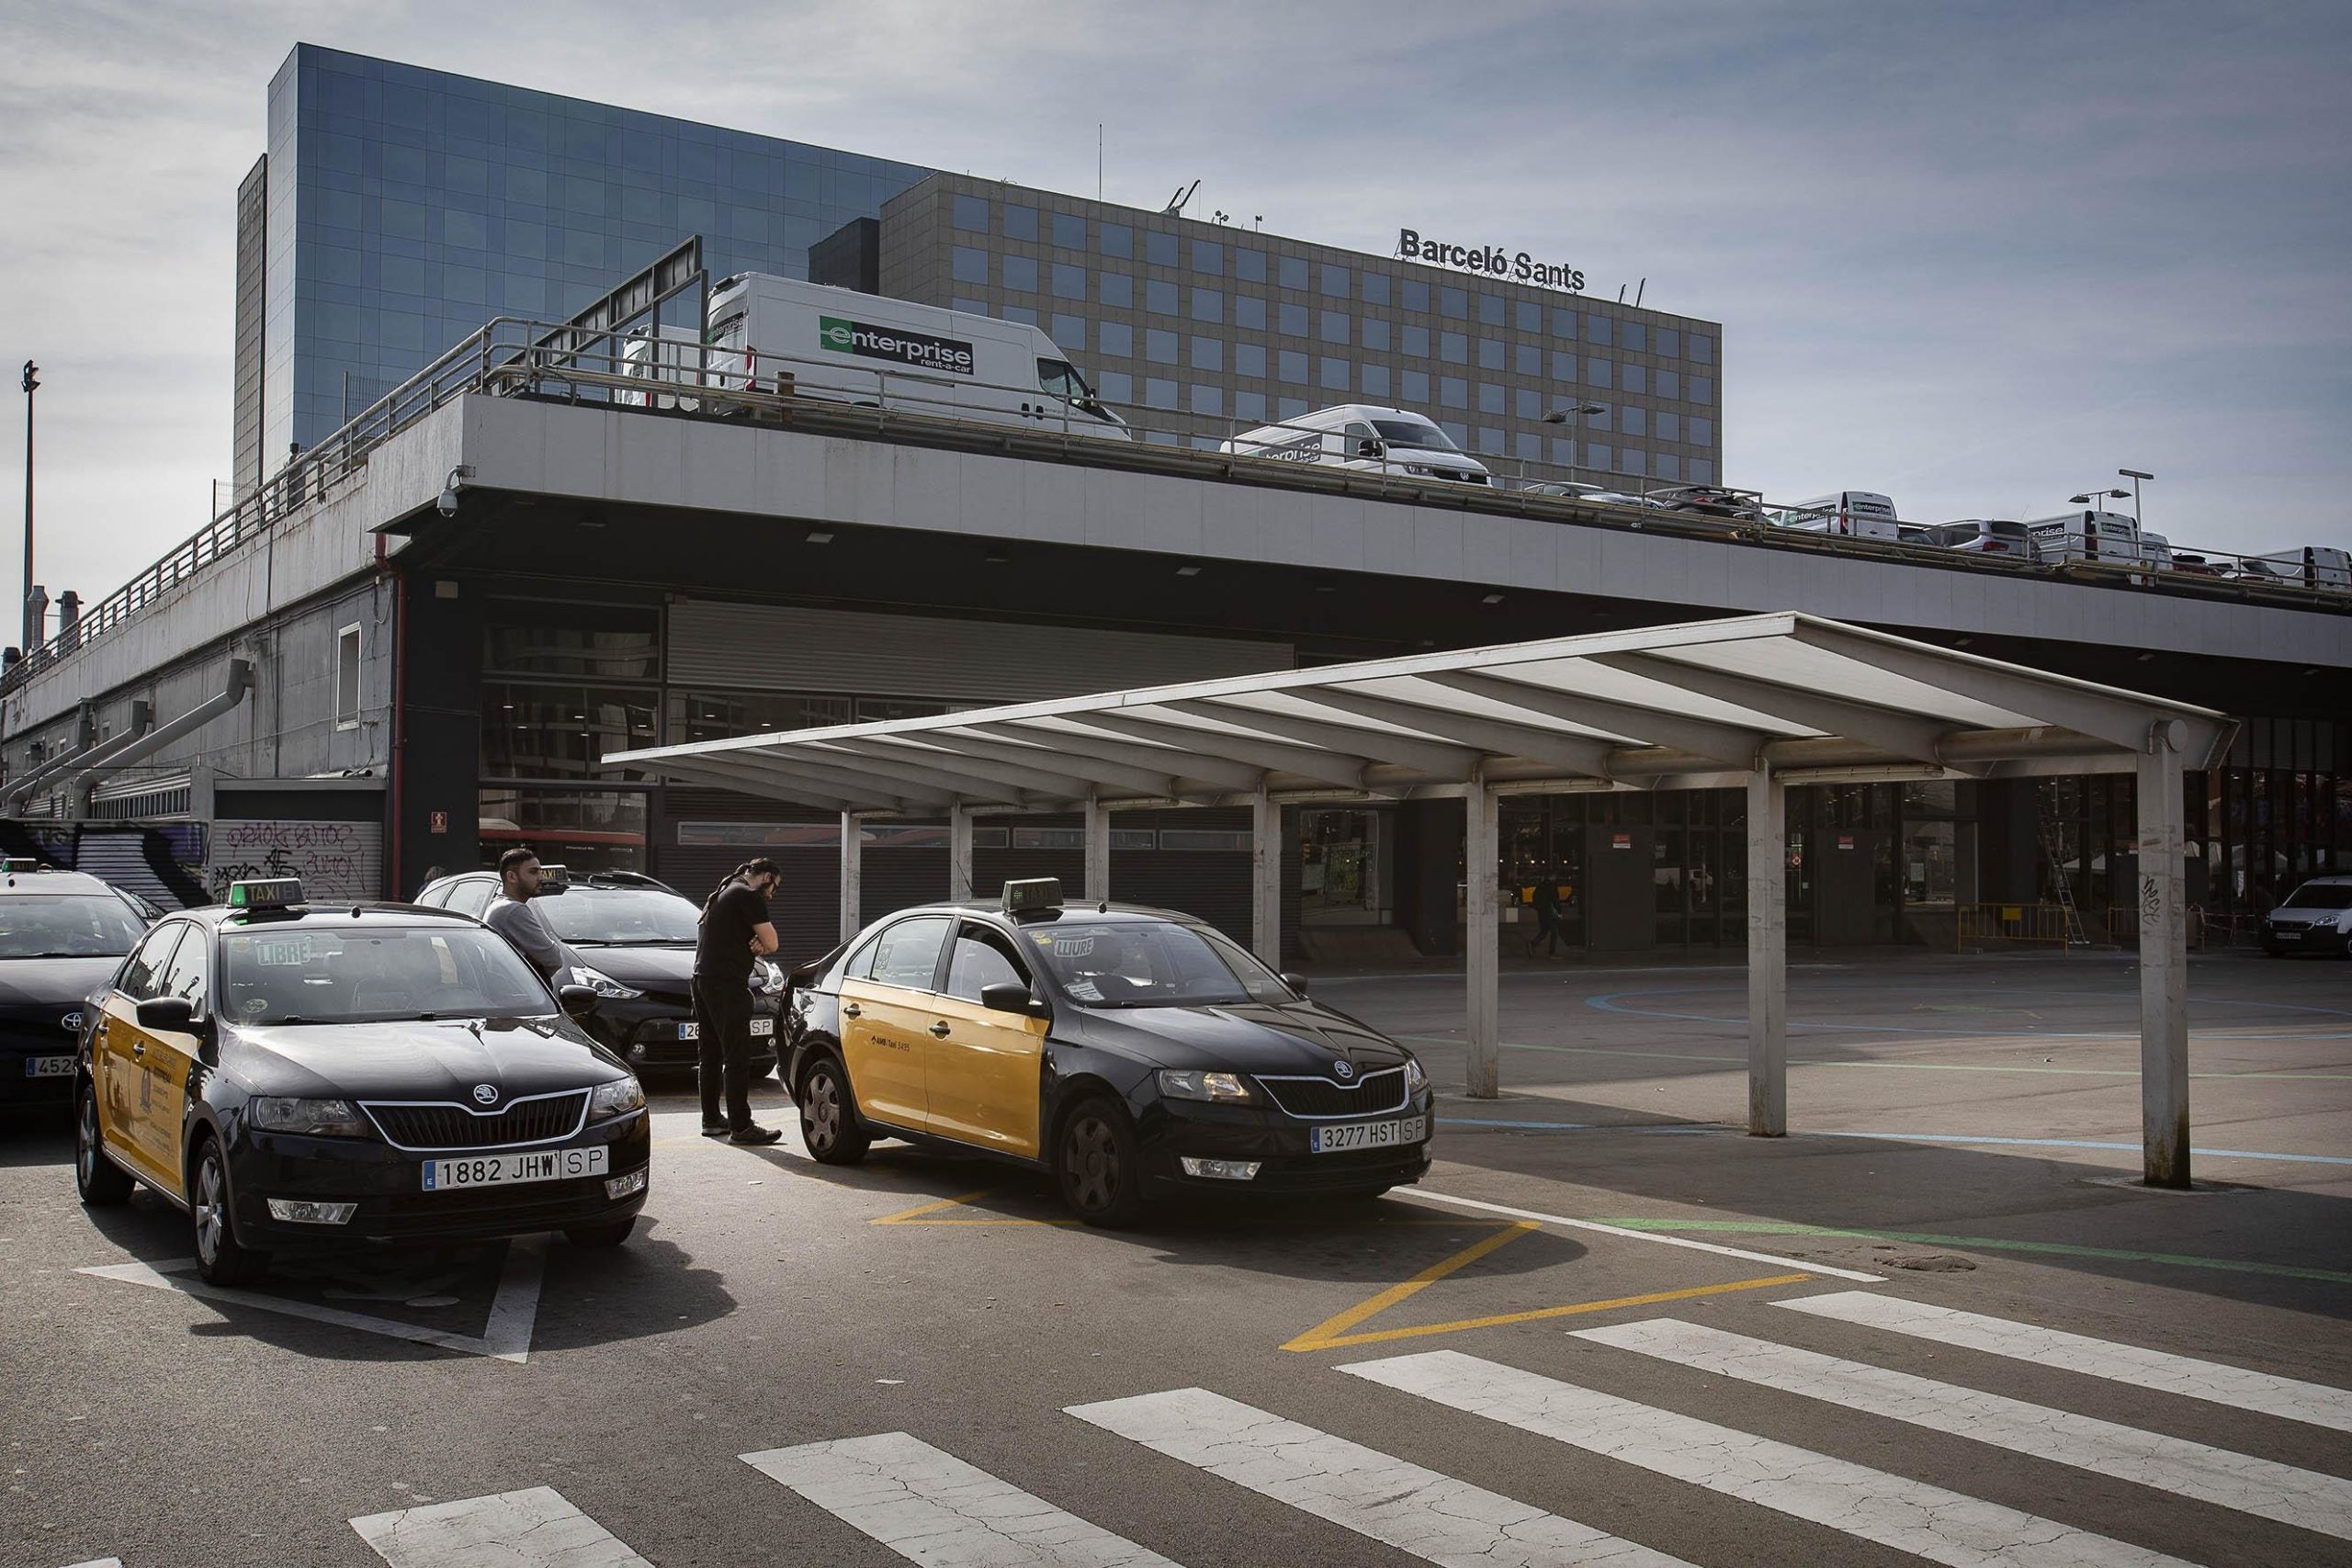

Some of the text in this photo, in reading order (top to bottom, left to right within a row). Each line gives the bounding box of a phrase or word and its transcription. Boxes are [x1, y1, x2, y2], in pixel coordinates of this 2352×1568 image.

[1400, 229, 1585, 290] Barceló Sants
[826, 326, 973, 366] enterprise
[921, 357, 971, 374] rent-a-car
[249, 884, 279, 901] TAXI
[258, 942, 311, 964] LIBRE
[1324, 1125, 1365, 1147] 3277
[1370, 1122, 1397, 1144] HST
[443, 1159, 502, 1185] 1882
[512, 1155, 553, 1179] JHW
